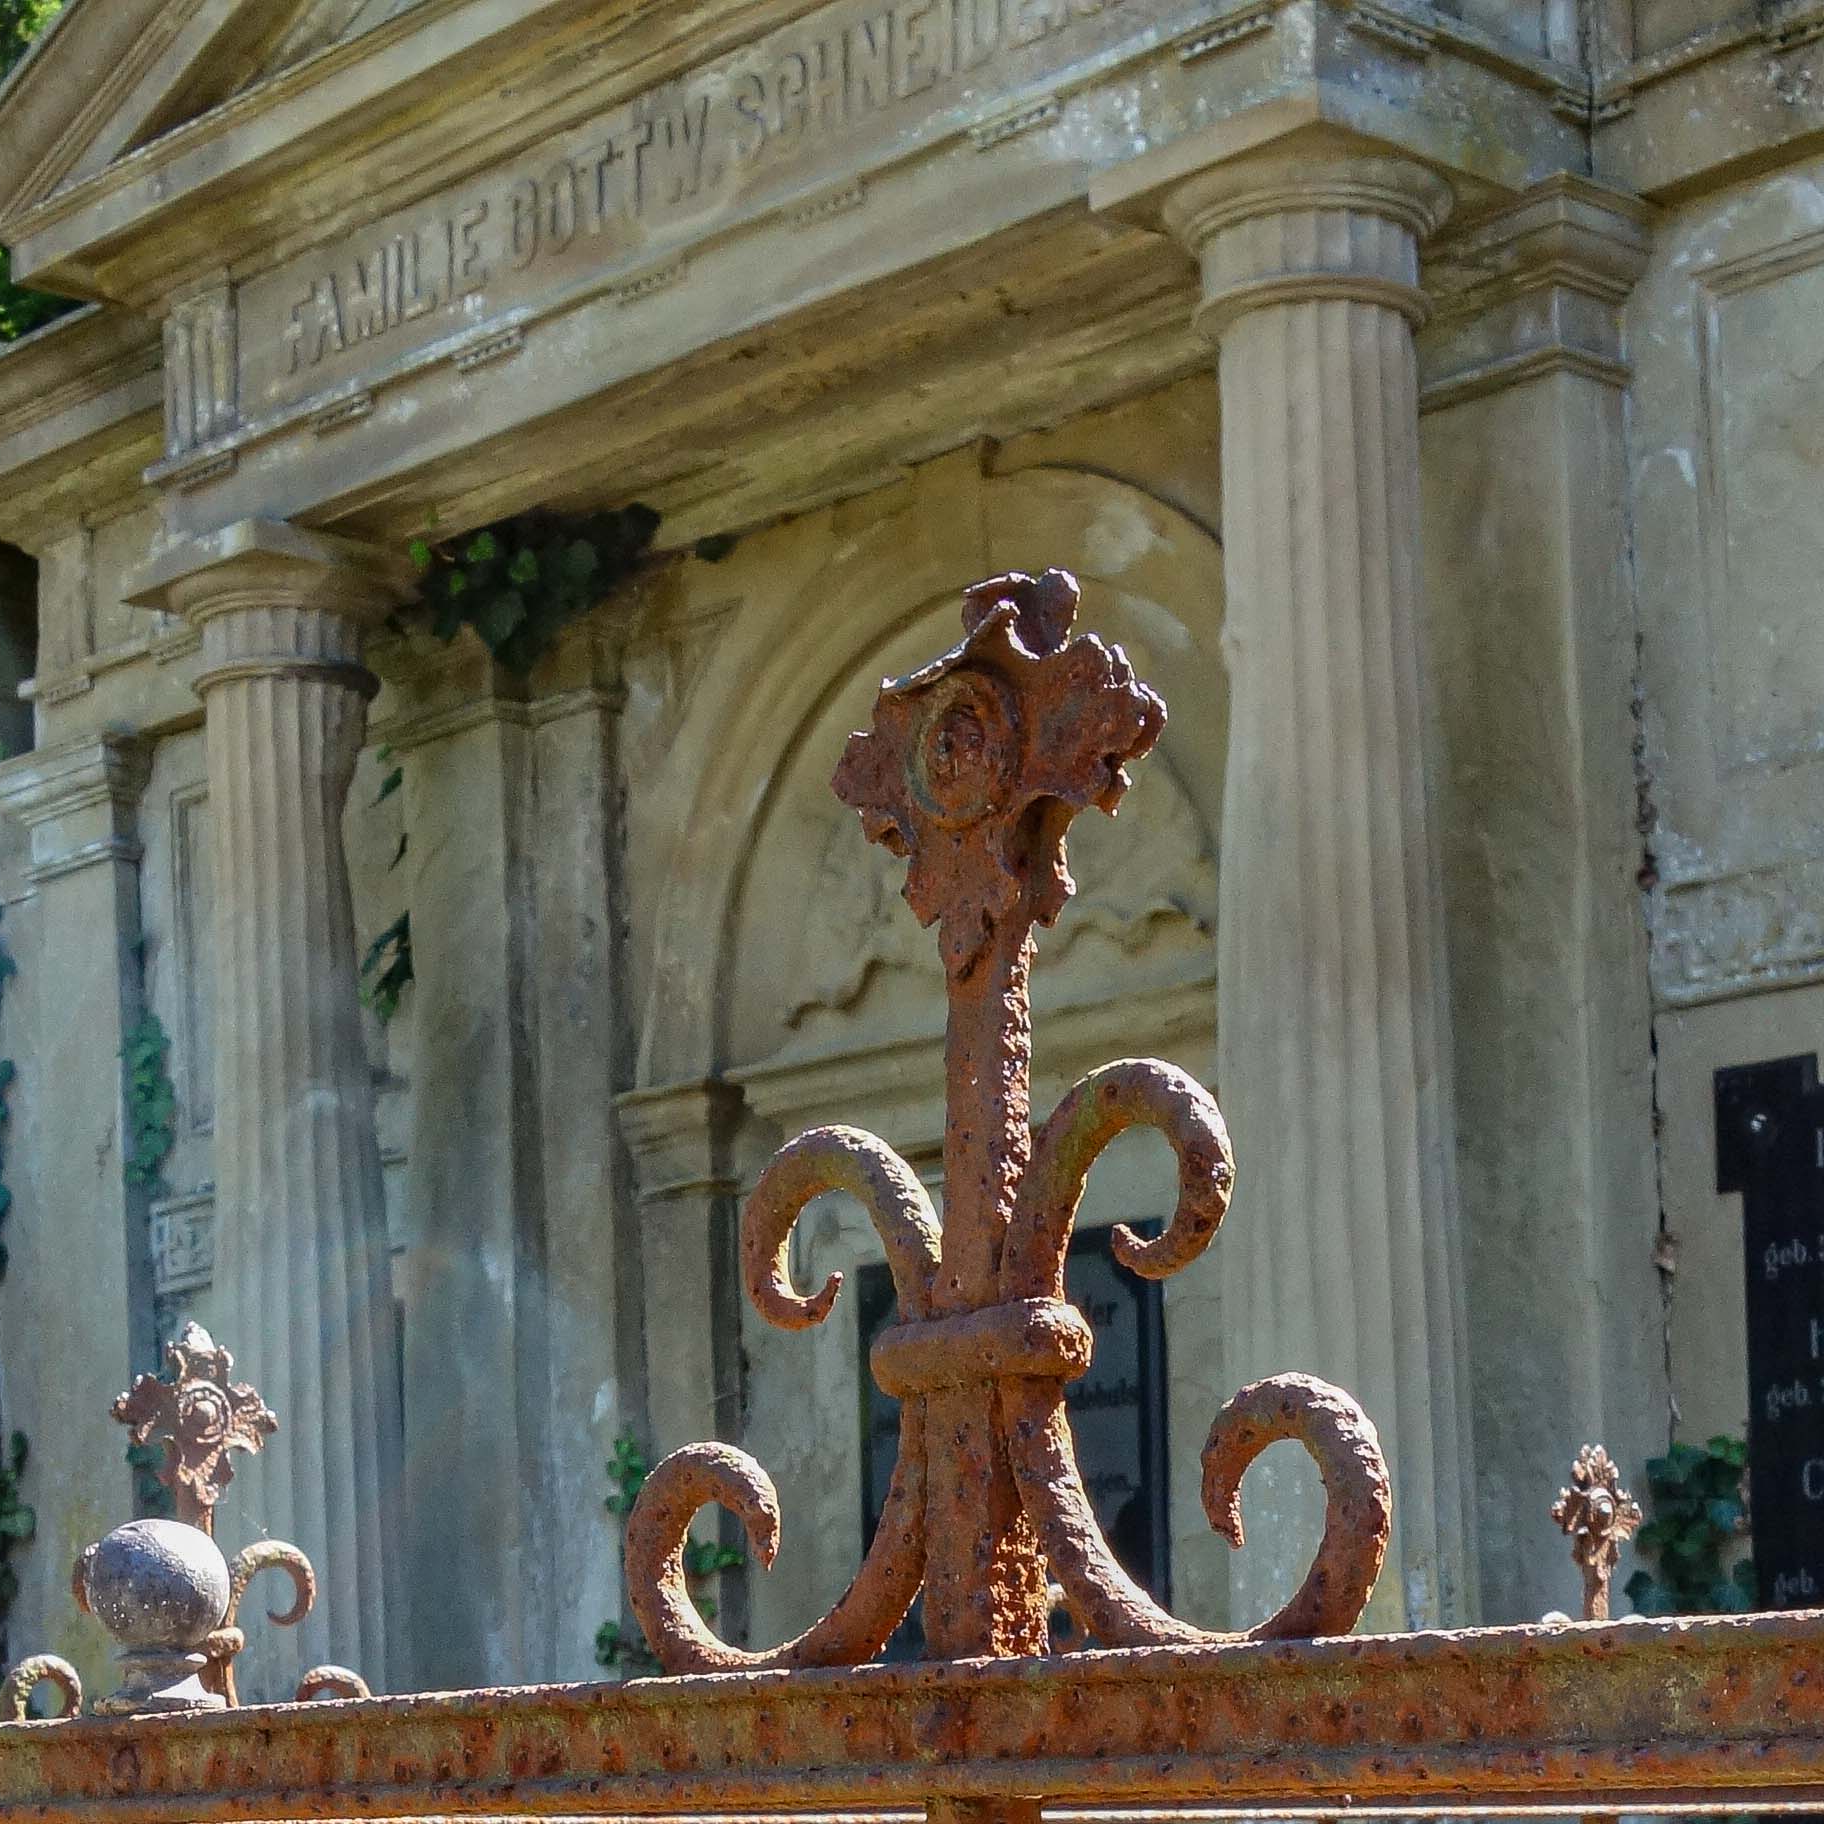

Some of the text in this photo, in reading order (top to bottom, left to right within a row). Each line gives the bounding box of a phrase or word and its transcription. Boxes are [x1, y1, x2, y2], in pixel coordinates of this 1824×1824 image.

[283, 200, 490, 376] FAMILIE
[1764, 1238, 1814, 1279] geb.
[1766, 1378, 1813, 1420] geb.
